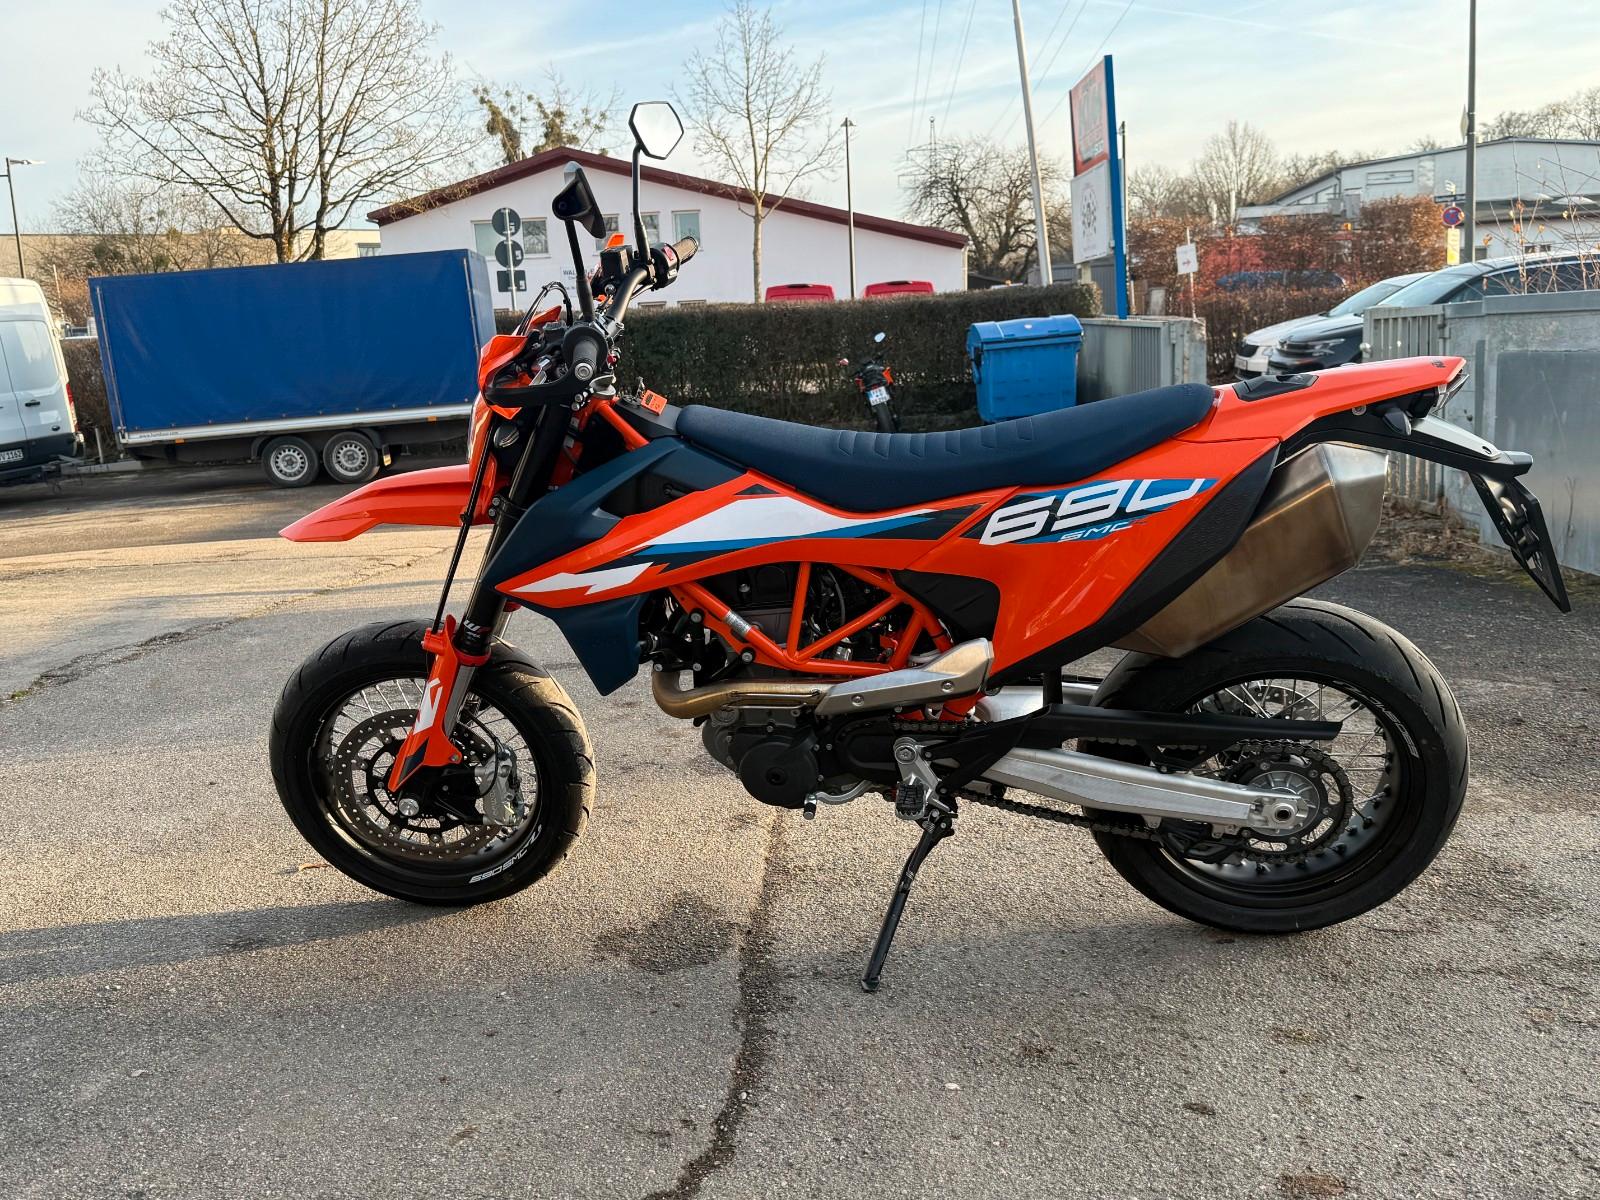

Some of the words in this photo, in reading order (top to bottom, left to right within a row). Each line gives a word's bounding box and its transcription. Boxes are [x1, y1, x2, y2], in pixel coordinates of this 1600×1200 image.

[979, 478, 1206, 545] 690
[1057, 521, 1133, 543] SMC
[469, 865, 503, 883] 690
[502, 849, 528, 871] SMC
